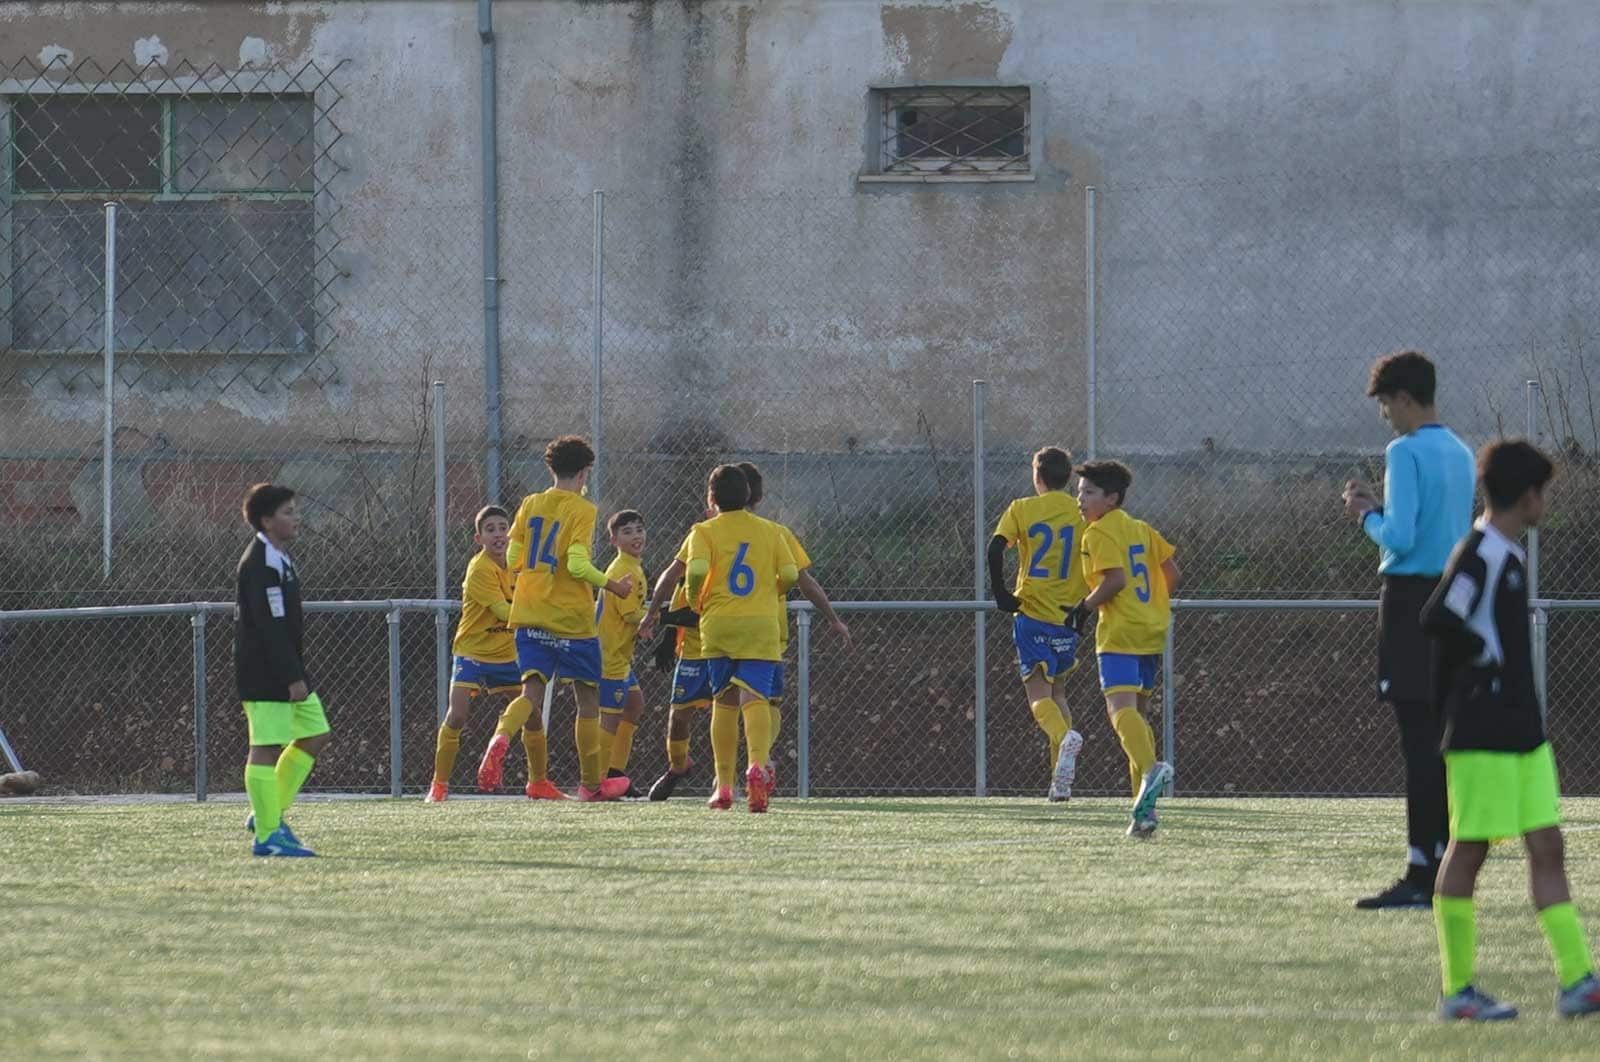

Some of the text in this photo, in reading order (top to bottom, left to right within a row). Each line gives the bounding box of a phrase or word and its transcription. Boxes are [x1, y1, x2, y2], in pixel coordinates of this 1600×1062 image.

[527, 516, 561, 575] 14
[728, 542, 755, 598] 6
[1028, 522, 1075, 580] 21
[1128, 543, 1151, 604] 5
